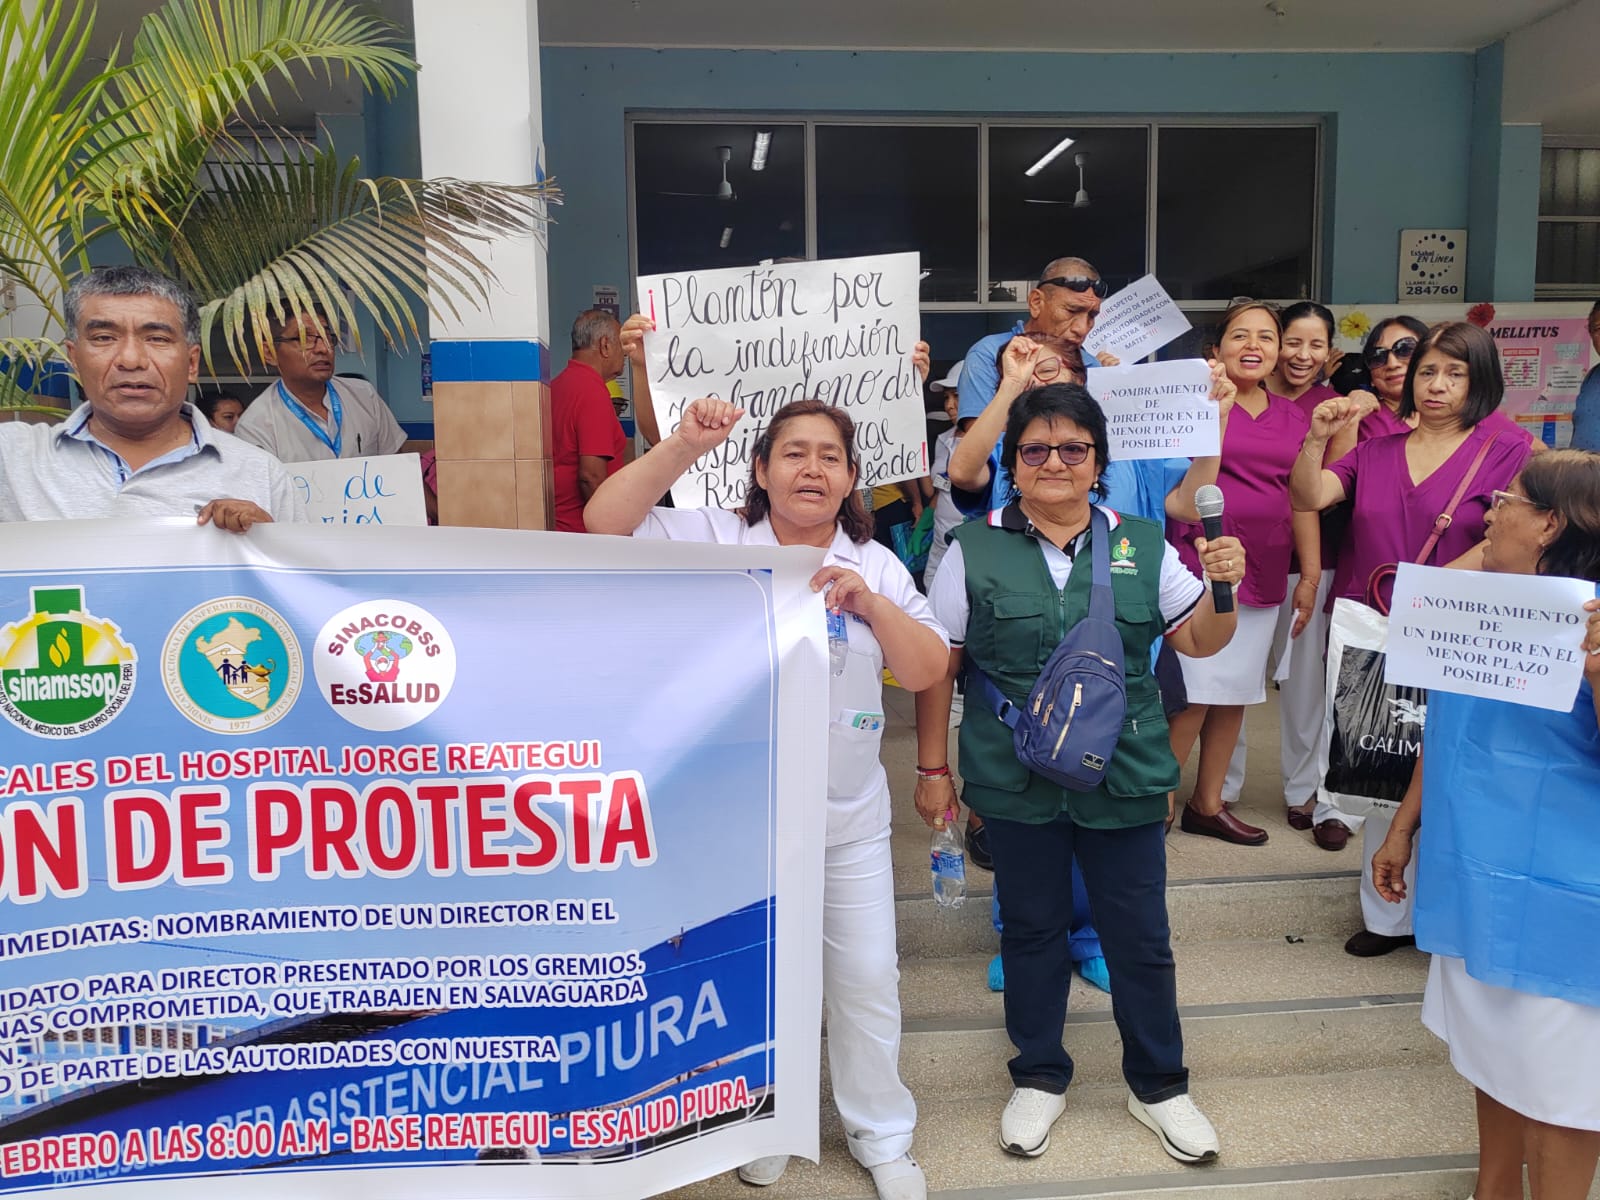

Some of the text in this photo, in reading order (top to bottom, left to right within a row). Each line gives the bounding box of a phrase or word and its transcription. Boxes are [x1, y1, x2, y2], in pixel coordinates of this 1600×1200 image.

[822, 271, 893, 323] por
[1132, 302, 1141, 311] DE
[1141, 292, 1161, 305] PARTE
[1406, 285, 1458, 295] 284760
[1112, 306, 1156, 335] AUTORIDADES
[1156, 298, 1170, 309] CON
[1490, 326, 1560, 339] MELLITUS
[657, 318, 905, 382] la indefensión
[705, 369, 883, 419] bandono
[1145, 400, 1160, 408] DE
[1110, 425, 1194, 436] MENOR PLAZO
[1113, 411, 1173, 423] DIRECTOR
[1177, 411, 1193, 420] EN
[1197, 411, 1213, 420] EL
[1121, 438, 1180, 448] POSIBLE!!
[328, 614, 440, 657] SINACOBSS
[1403, 626, 1577, 663] UN DIRECTOR EN EL
[1479, 619, 1503, 633] DE
[1426, 646, 1549, 676] MENOR PLAZO
[1443, 665, 1528, 691] POSIBLE!!
[9, 668, 116, 705] sinamssop
[330, 683, 440, 705] EsSALUD
[63, 726, 78, 735] DEL
[79, 713, 108, 733] SEGURO
[104, 695, 127, 717] SOCIAL
[229, 721, 251, 730] 1977
[107, 756, 171, 784] DEL
[183, 749, 333, 778] HOSPITAL
[341, 747, 438, 773] JORGE
[448, 742, 600, 771] REATEGUI
[0, 777, 650, 896] N DE PROTESTA
[158, 909, 357, 937] NOMBRAMIENTO
[365, 908, 393, 926] DE
[401, 907, 432, 925] UN
[441, 904, 549, 924] DIRECTOR
[556, 903, 584, 921] EN
[592, 902, 616, 921] EL
[89, 975, 151, 997] PARA
[162, 967, 276, 991] DIRECTOR
[284, 961, 429, 983] PRESENTADO
[437, 959, 482, 978] POR
[490, 958, 528, 976] LOS
[535, 953, 643, 976] GREMIOS.
[52, 995, 266, 1028] COMPROMETIDA,
[274, 992, 321, 1013] QUE
[332, 987, 441, 1009] TRABAJEN
[450, 986, 477, 1005] EN
[485, 980, 644, 1004] SALVAGUARDA
[560, 980, 727, 1084] PIURA
[21, 1066, 54, 1089] DE
[63, 1057, 138, 1082] PARTE
[147, 1055, 176, 1074] DE
[185, 1050, 225, 1071] LAS
[232, 1043, 393, 1069] AUTORIDADES
[400, 1042, 447, 1061] CON
[456, 1040, 556, 1060] NUESTRA
[0, 1134, 117, 1175] EBRERO
[125, 1131, 145, 1163] A
[153, 1127, 202, 1161] LAS
[209, 1124, 272, 1157] 8:00
[353, 1117, 419, 1150] BASE
[428, 1115, 547, 1148] REATEGUI
[571, 1098, 677, 1146] ESSALUD
[682, 1078, 754, 1119] PIURA.
